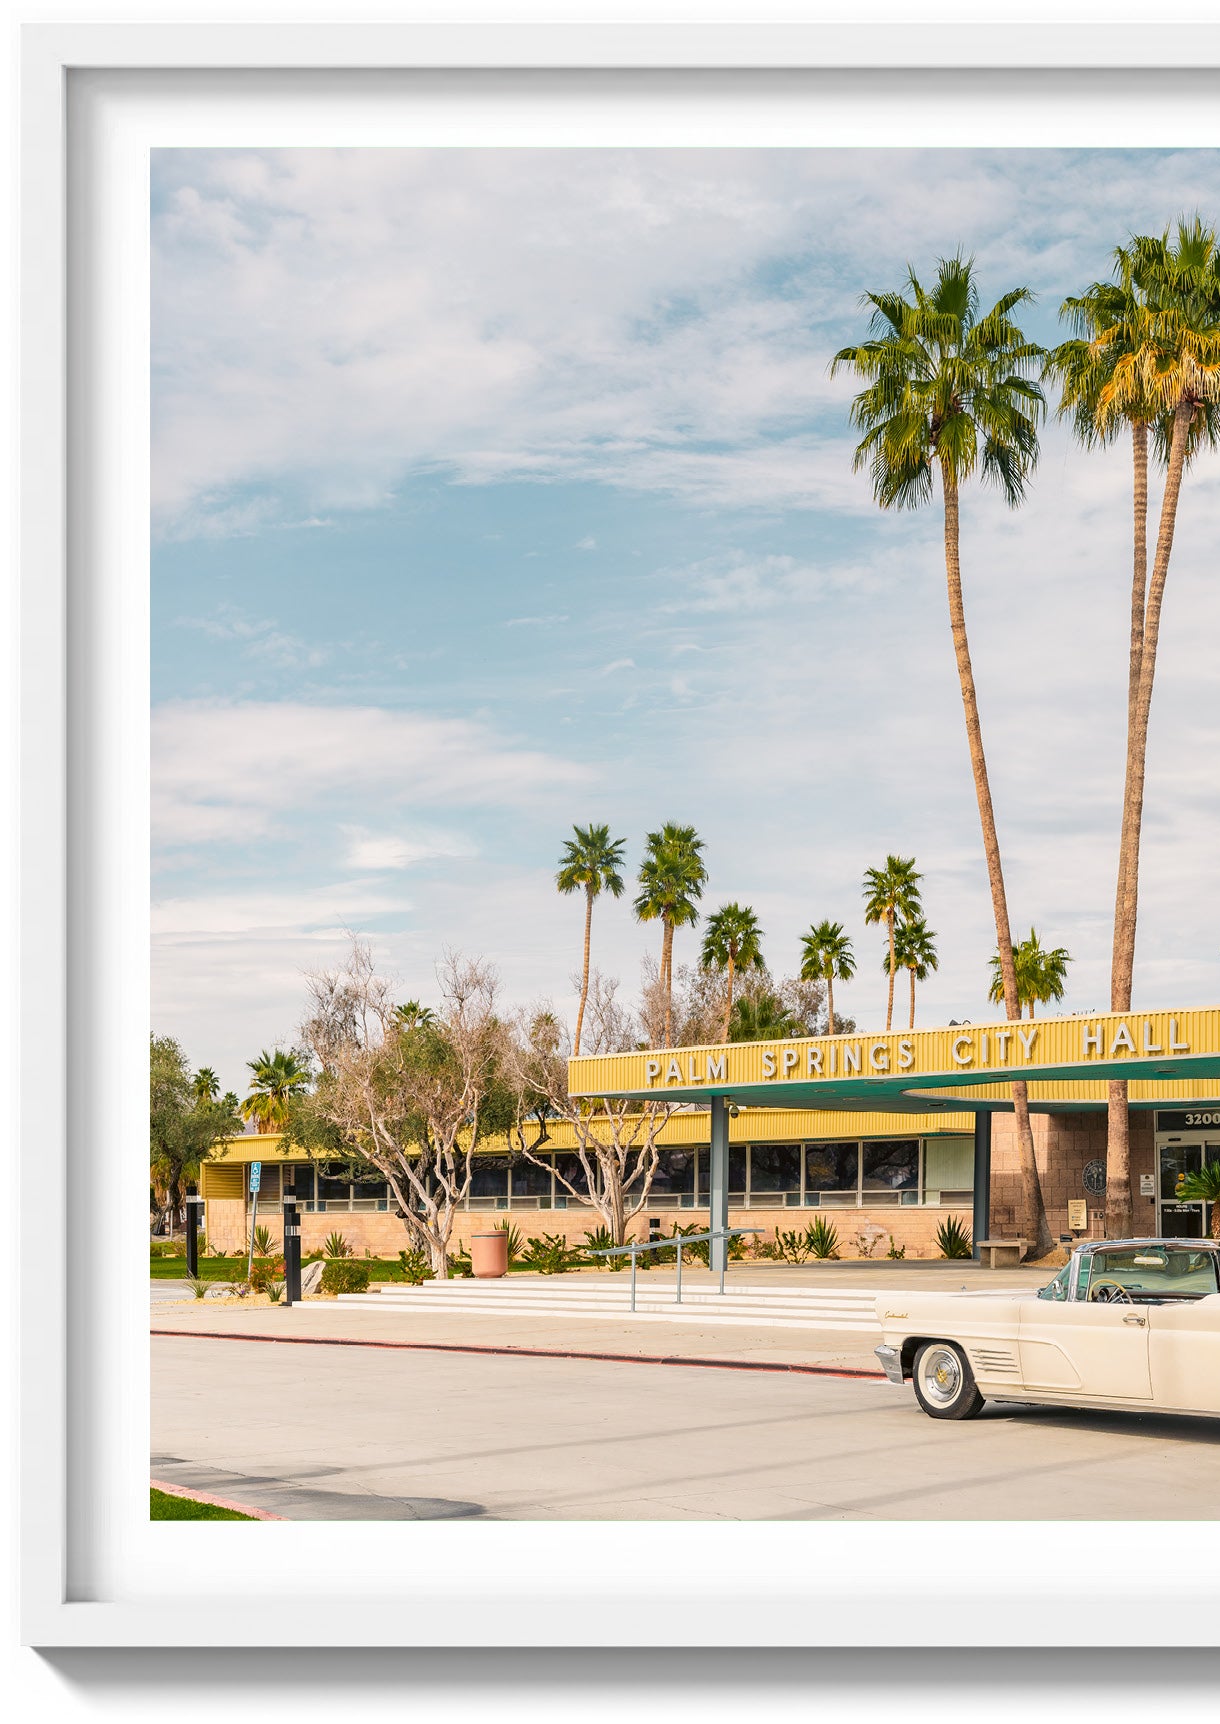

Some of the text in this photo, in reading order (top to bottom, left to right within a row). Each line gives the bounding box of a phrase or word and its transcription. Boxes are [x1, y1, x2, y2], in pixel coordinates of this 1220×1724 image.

[645, 1018, 1189, 1086] PALM SPRINGS CITY HALL
